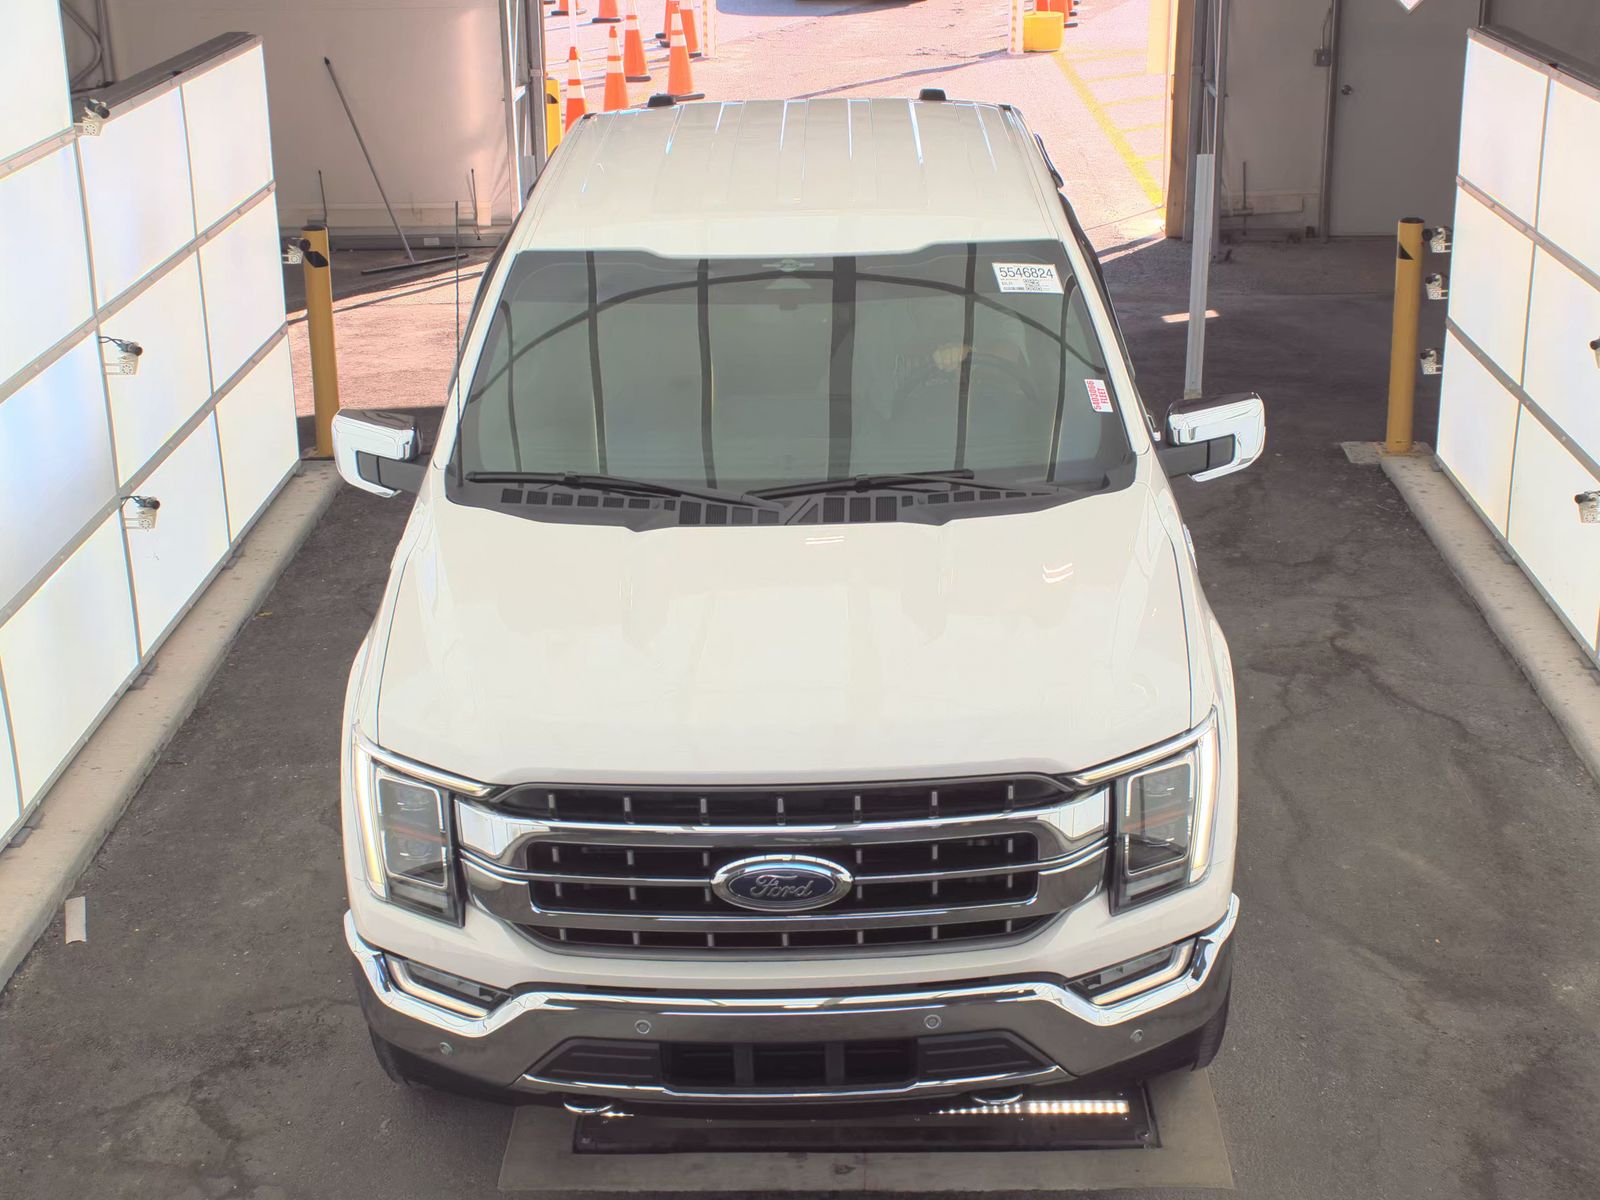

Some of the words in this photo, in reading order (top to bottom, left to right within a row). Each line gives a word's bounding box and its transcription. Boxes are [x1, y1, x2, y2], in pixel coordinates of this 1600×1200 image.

[999, 266, 1054, 279] 5546824
[1097, 388, 1109, 404] FLEET
[750, 874, 815, 897] Ford
